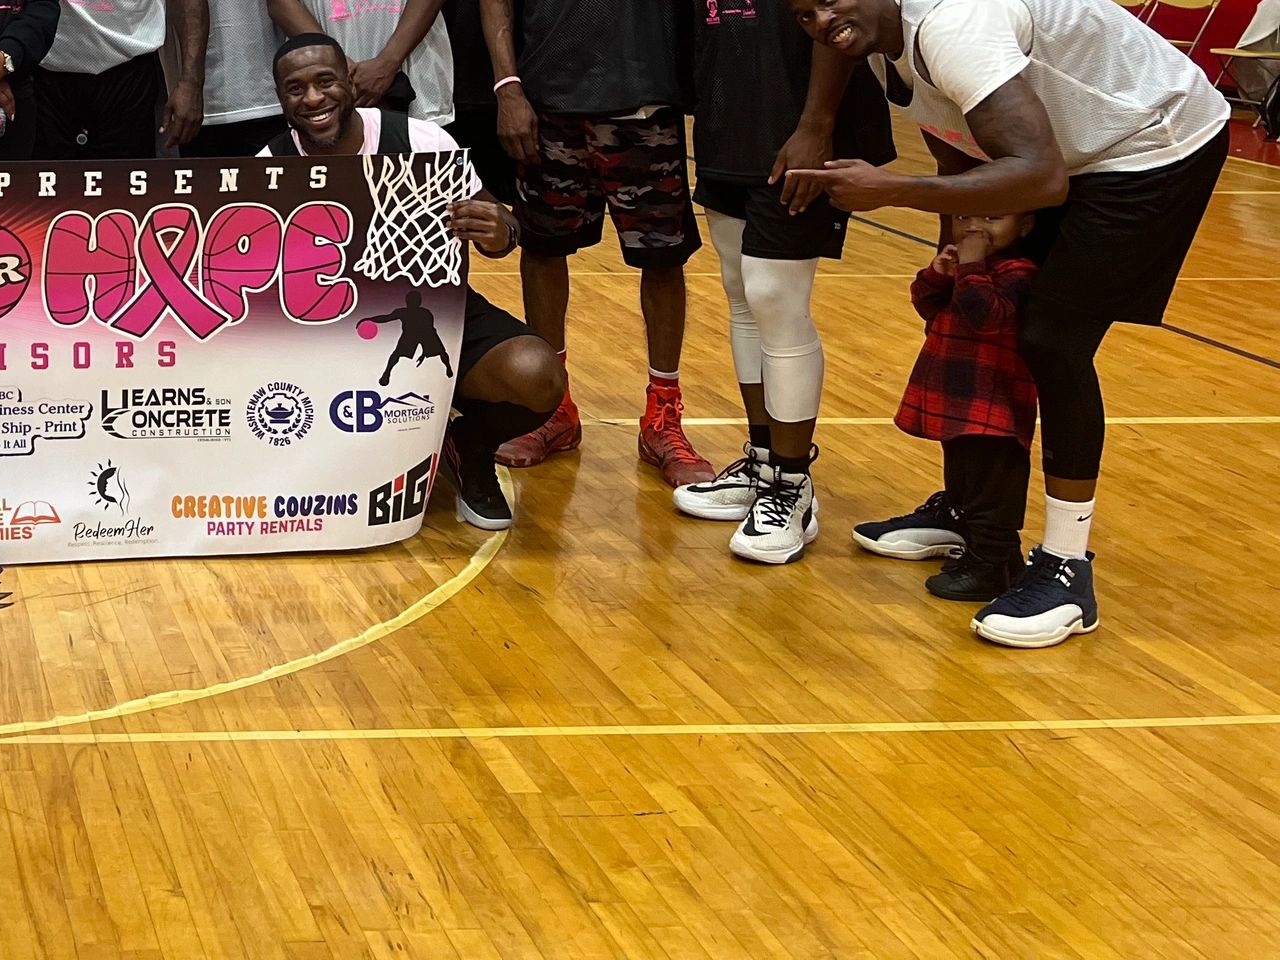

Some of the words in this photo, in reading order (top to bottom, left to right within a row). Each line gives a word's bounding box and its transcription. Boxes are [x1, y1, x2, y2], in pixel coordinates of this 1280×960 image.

[205, 397, 212, 406] &
[215, 397, 232, 405] SON
[38, 402, 85, 414] Center
[246, 386, 267, 440] WASHTENAW
[267, 381, 305, 397] COUNTY
[294, 396, 314, 440] MICHIGAN
[383, 405, 436, 418] MORTGAGE
[387, 414, 431, 424] SOLUTIONS
[1, 421, 32, 436] Ship
[44, 420, 78, 432] Print
[132, 428, 231, 437] CONSTRUCTION
[3, 440, 11, 449] It
[12, 439, 27, 449] All
[269, 436, 291, 447] 1826
[171, 495, 267, 519] CREATIVE
[273, 493, 359, 519] COUZINS
[207, 521, 255, 536] PARTY
[260, 518, 324, 535] RENTALS
